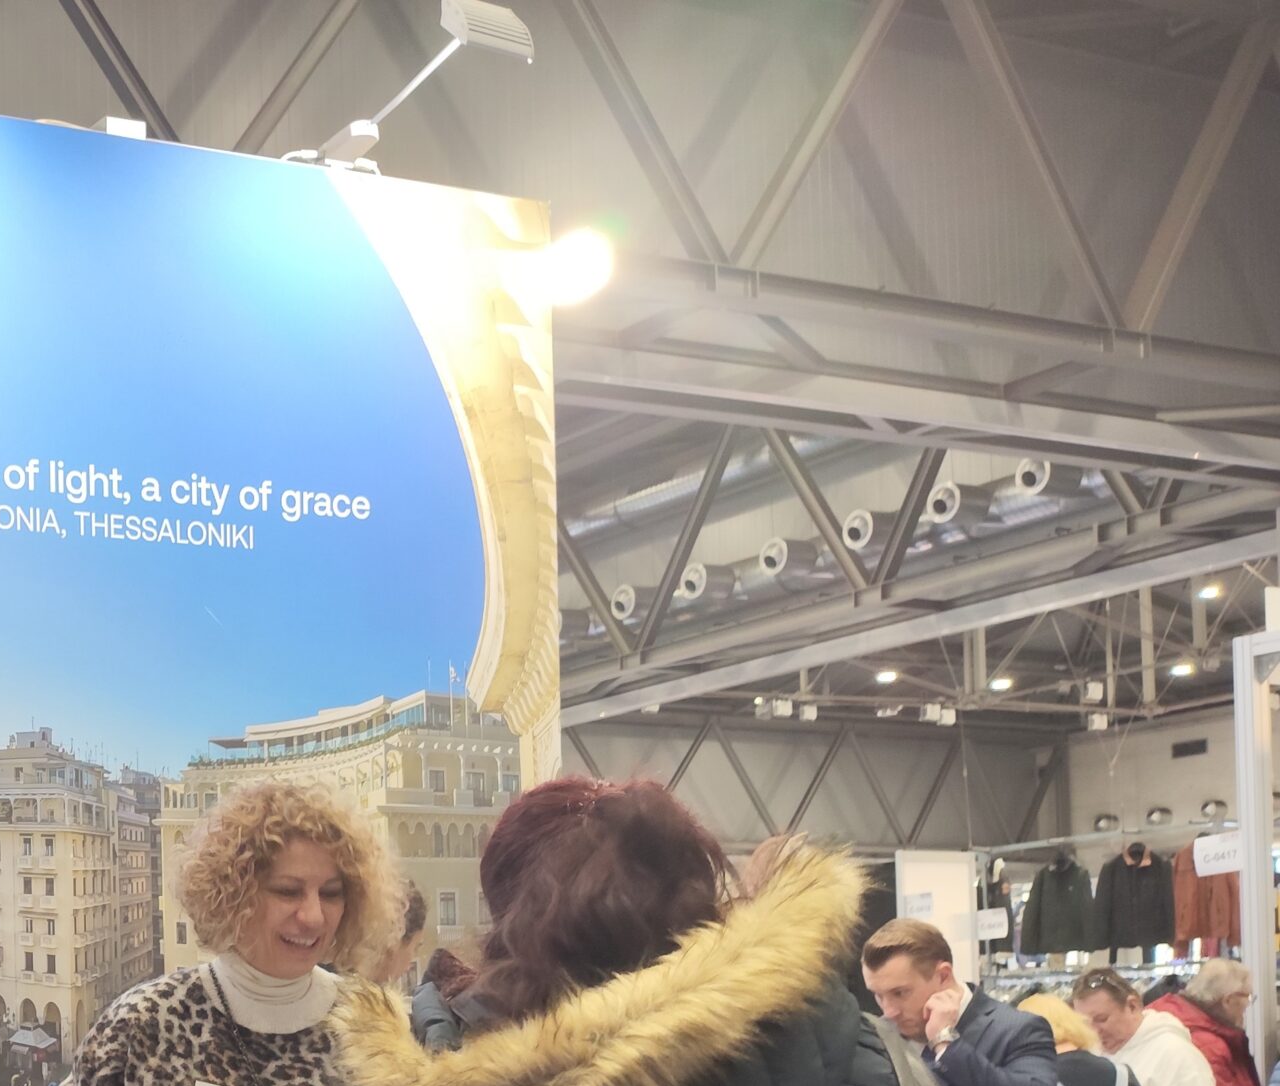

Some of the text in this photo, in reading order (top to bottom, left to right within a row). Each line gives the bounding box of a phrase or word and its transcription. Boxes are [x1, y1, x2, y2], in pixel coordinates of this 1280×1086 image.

[3, 459, 40, 491] of
[49, 460, 132, 504] light,
[141, 473, 162, 502] a
[170, 471, 231, 515] city
[238, 480, 273, 511] of
[280, 489, 371, 523] grace
[73, 511, 255, 550] THESSALONIKI
